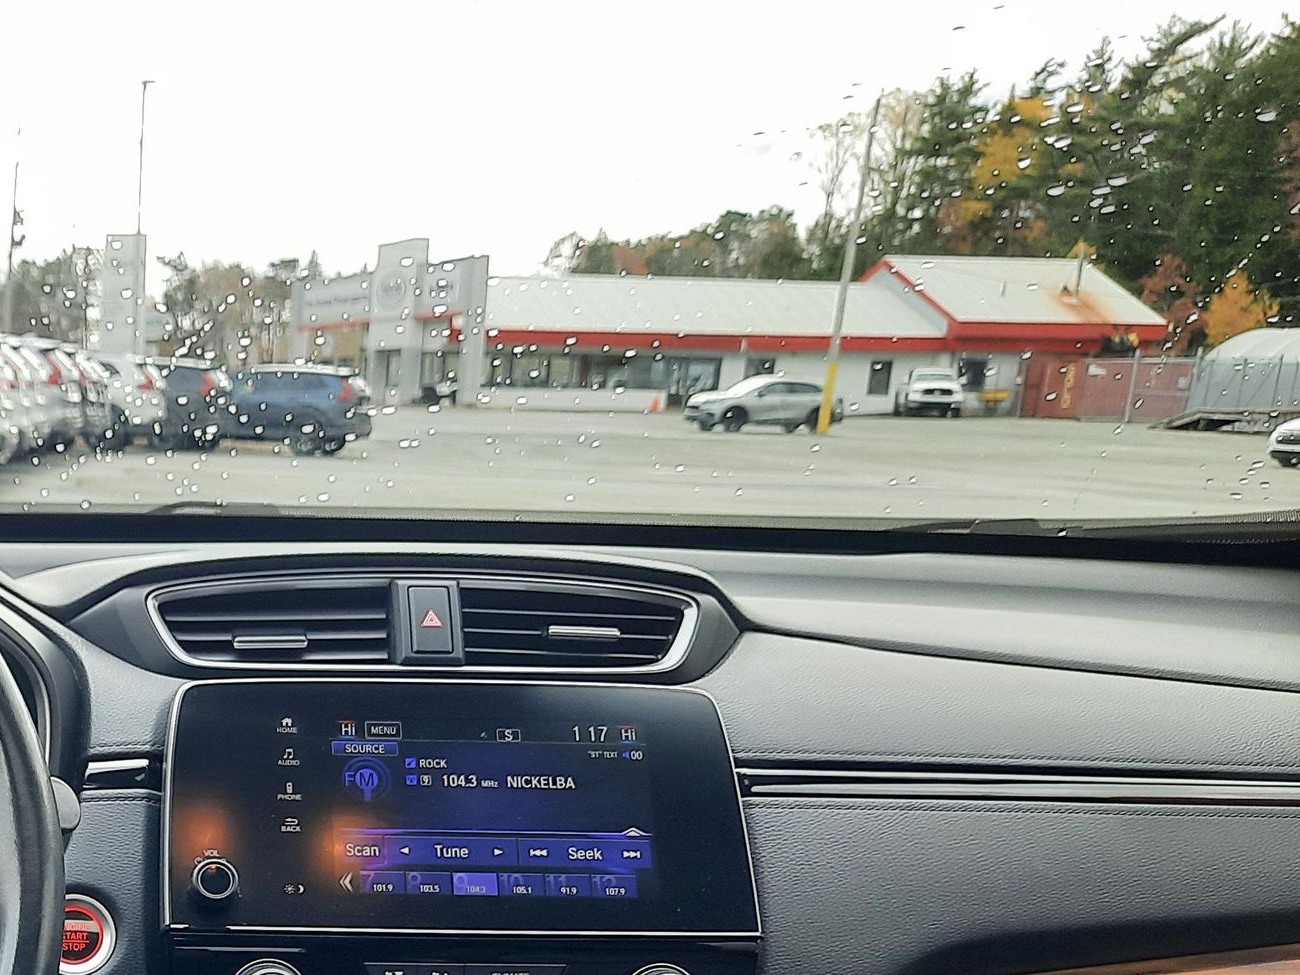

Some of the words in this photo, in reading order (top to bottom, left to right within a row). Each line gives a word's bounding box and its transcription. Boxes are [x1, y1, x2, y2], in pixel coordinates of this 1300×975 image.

[341, 723, 356, 736] Hi
[370, 726, 396, 735] MENU
[621, 728, 636, 741] Hi
[345, 744, 385, 754] SOURCE
[630, 751, 643, 760] 00
[419, 759, 447, 769] ROCK
[442, 775, 477, 787] 104.3
[507, 776, 576, 789] NICKELBA
[203, 849, 220, 857] VOL
[345, 844, 380, 857] Scan
[434, 845, 469, 858] Tune
[568, 847, 603, 860] Seek
[372, 884, 393, 892] 101.9
[605, 887, 626, 896] 107.9
[62, 942, 86, 951] STOP
